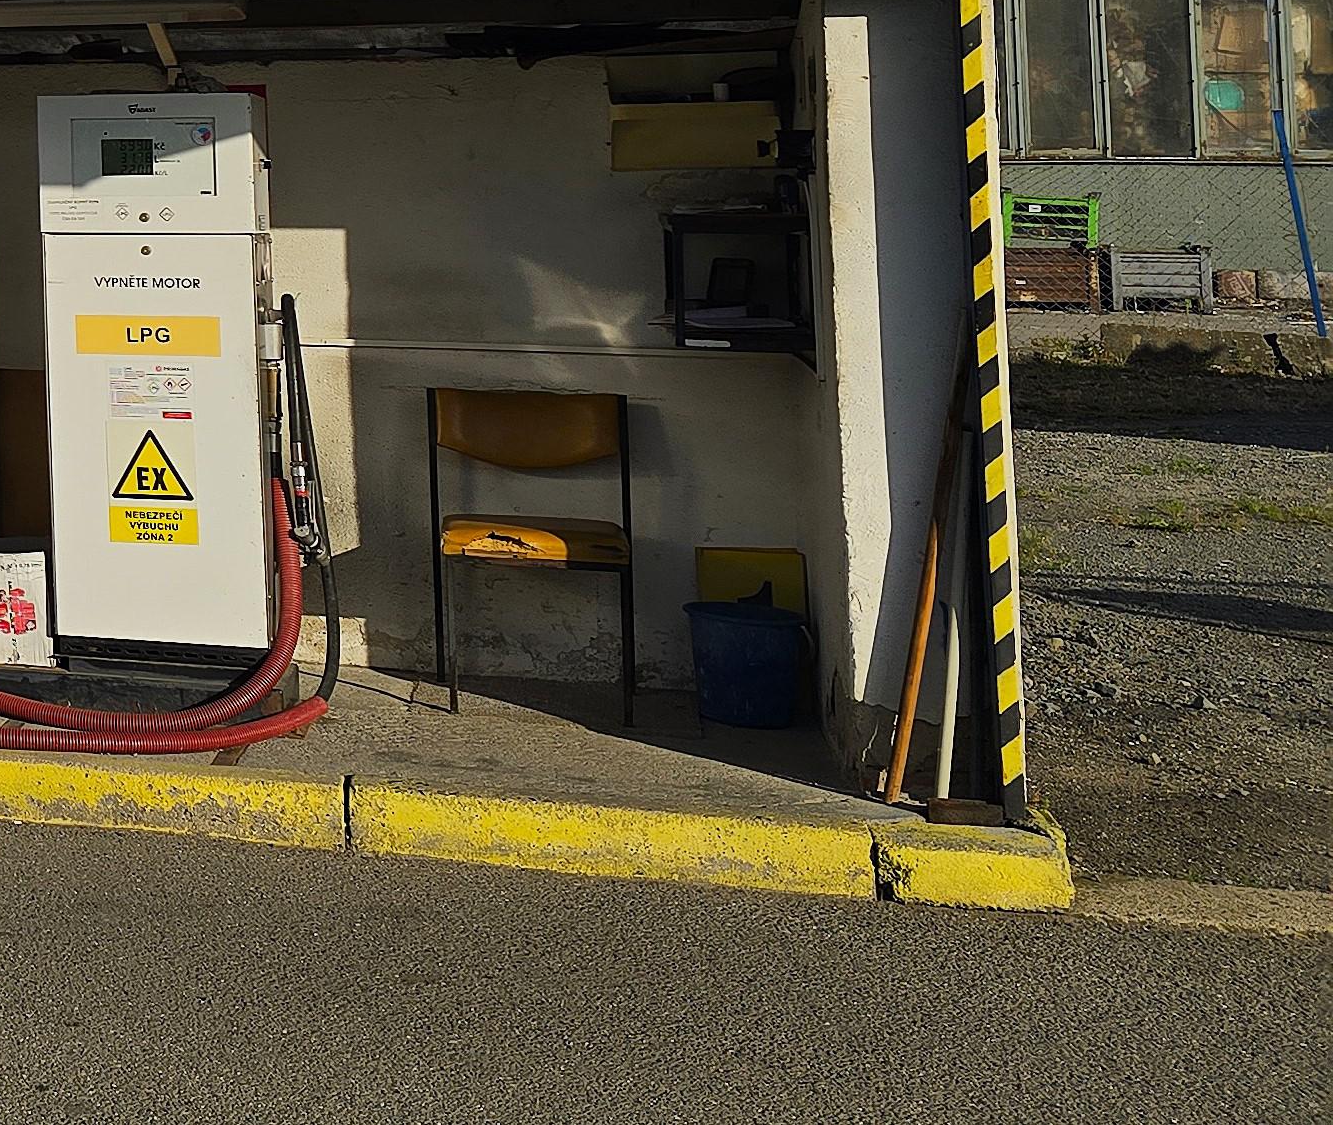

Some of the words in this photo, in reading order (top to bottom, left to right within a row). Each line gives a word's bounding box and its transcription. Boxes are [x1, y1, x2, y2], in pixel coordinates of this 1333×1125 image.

[94, 275, 148, 288] VYPNĚTE
[153, 278, 200, 289] MOTOR
[126, 327, 170, 343] LPG
[136, 467, 168, 491] EX
[125, 511, 182, 520] NEBEZPEČÍ
[129, 520, 179, 531] VÝBUCHU
[136, 531, 165, 541] ZÓNA
